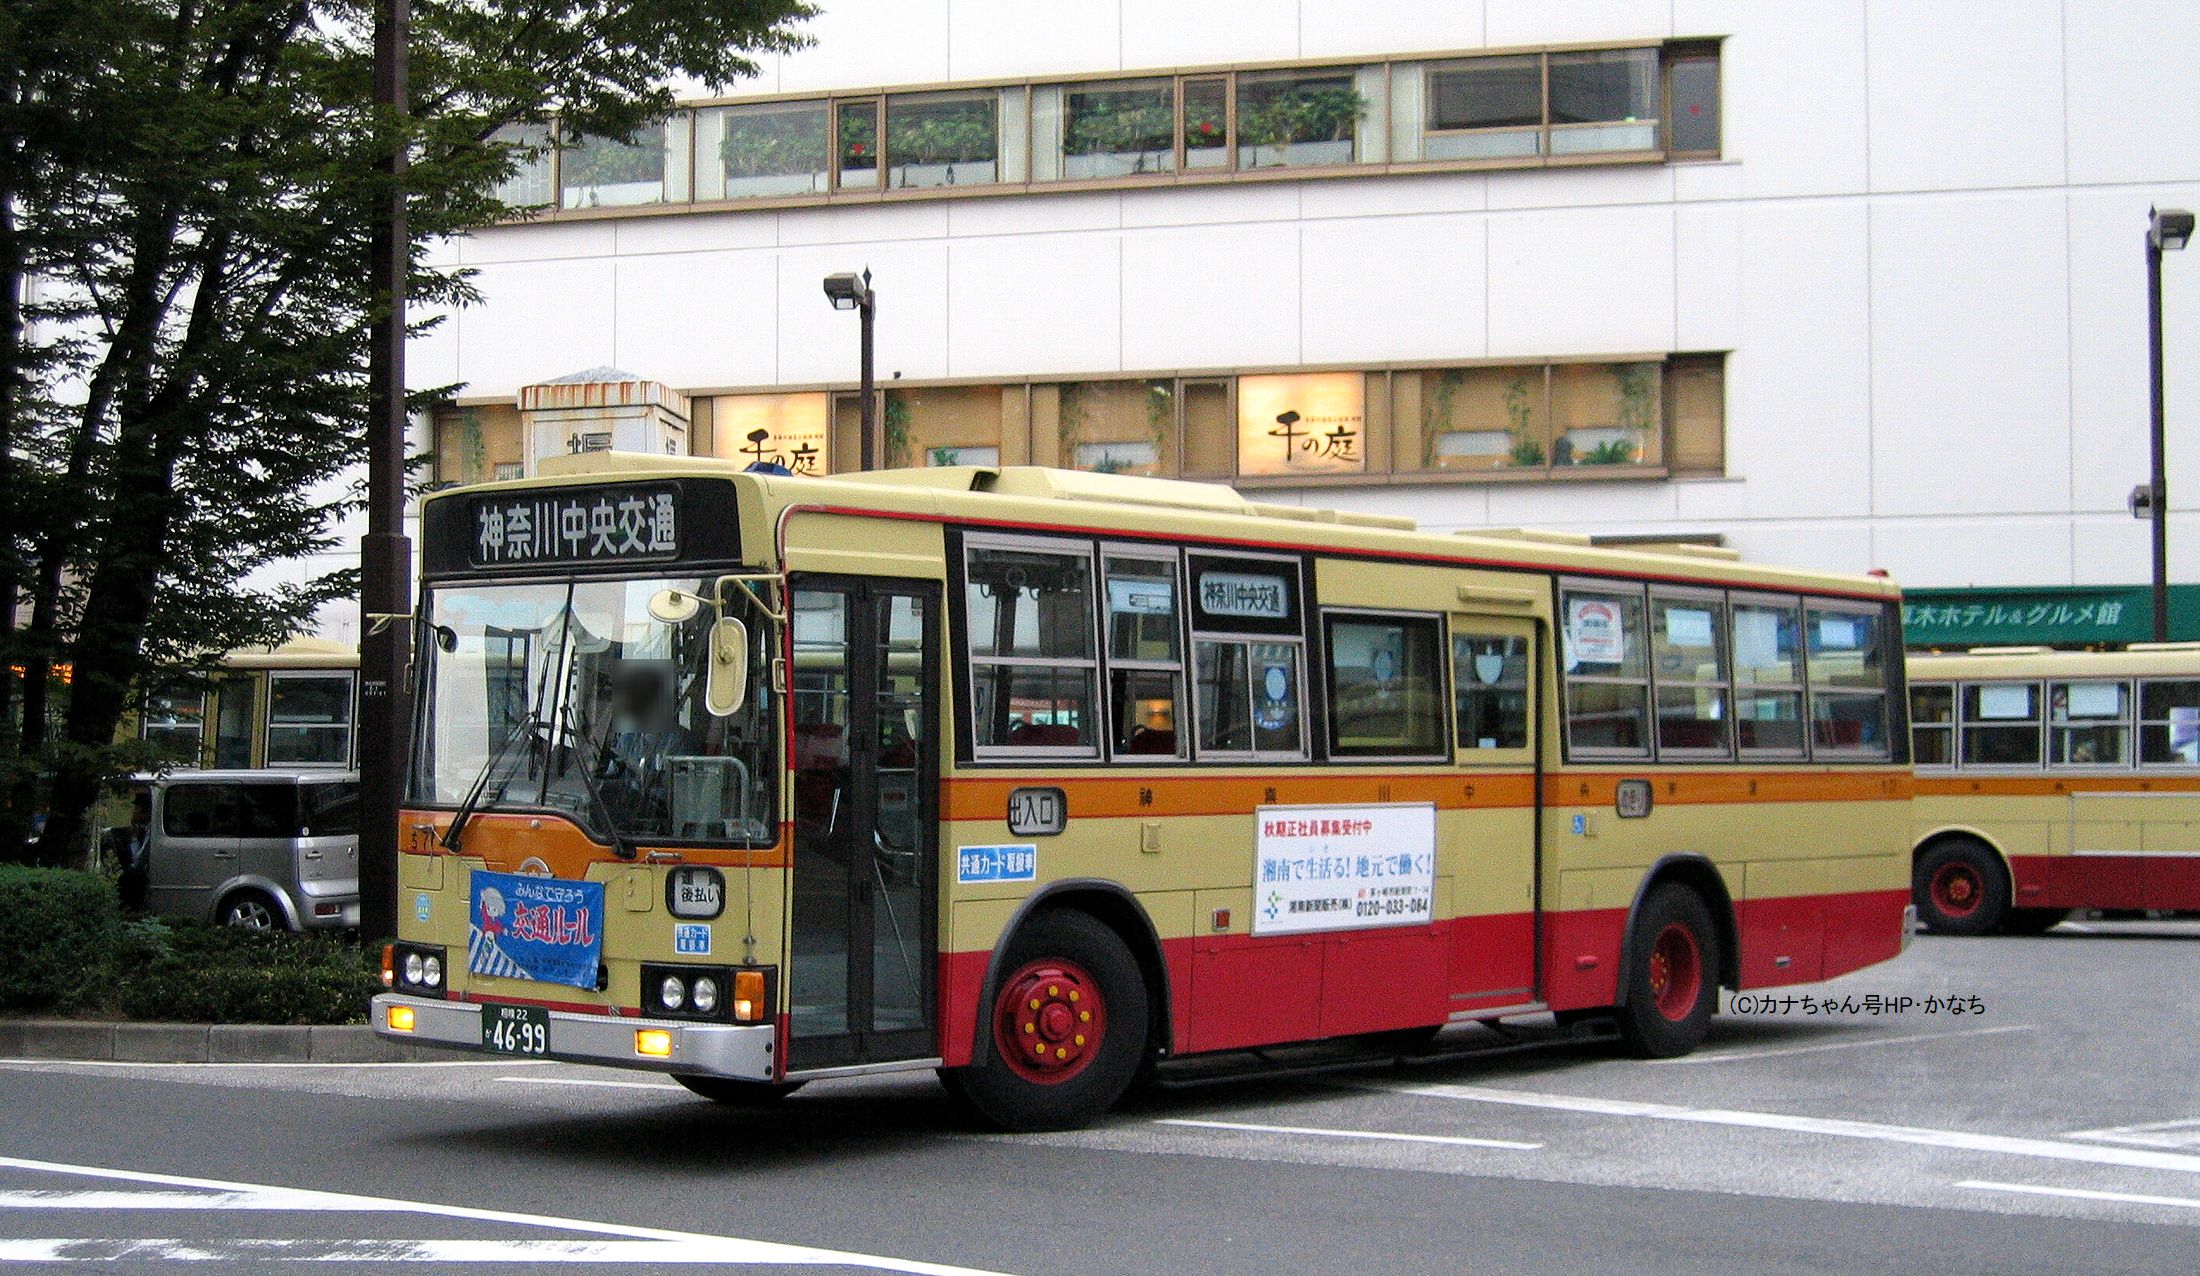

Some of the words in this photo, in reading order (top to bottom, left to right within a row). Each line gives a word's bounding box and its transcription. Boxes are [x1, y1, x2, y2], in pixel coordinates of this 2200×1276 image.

[1268, 410, 1360, 462] 千の庭
[478, 493, 677, 561] 神奈川中央交通
[1205, 581, 1281, 613] 神奈川中央交通
[511, 901, 595, 947] 交通ルール
[516, 1008, 528, 1021] 22
